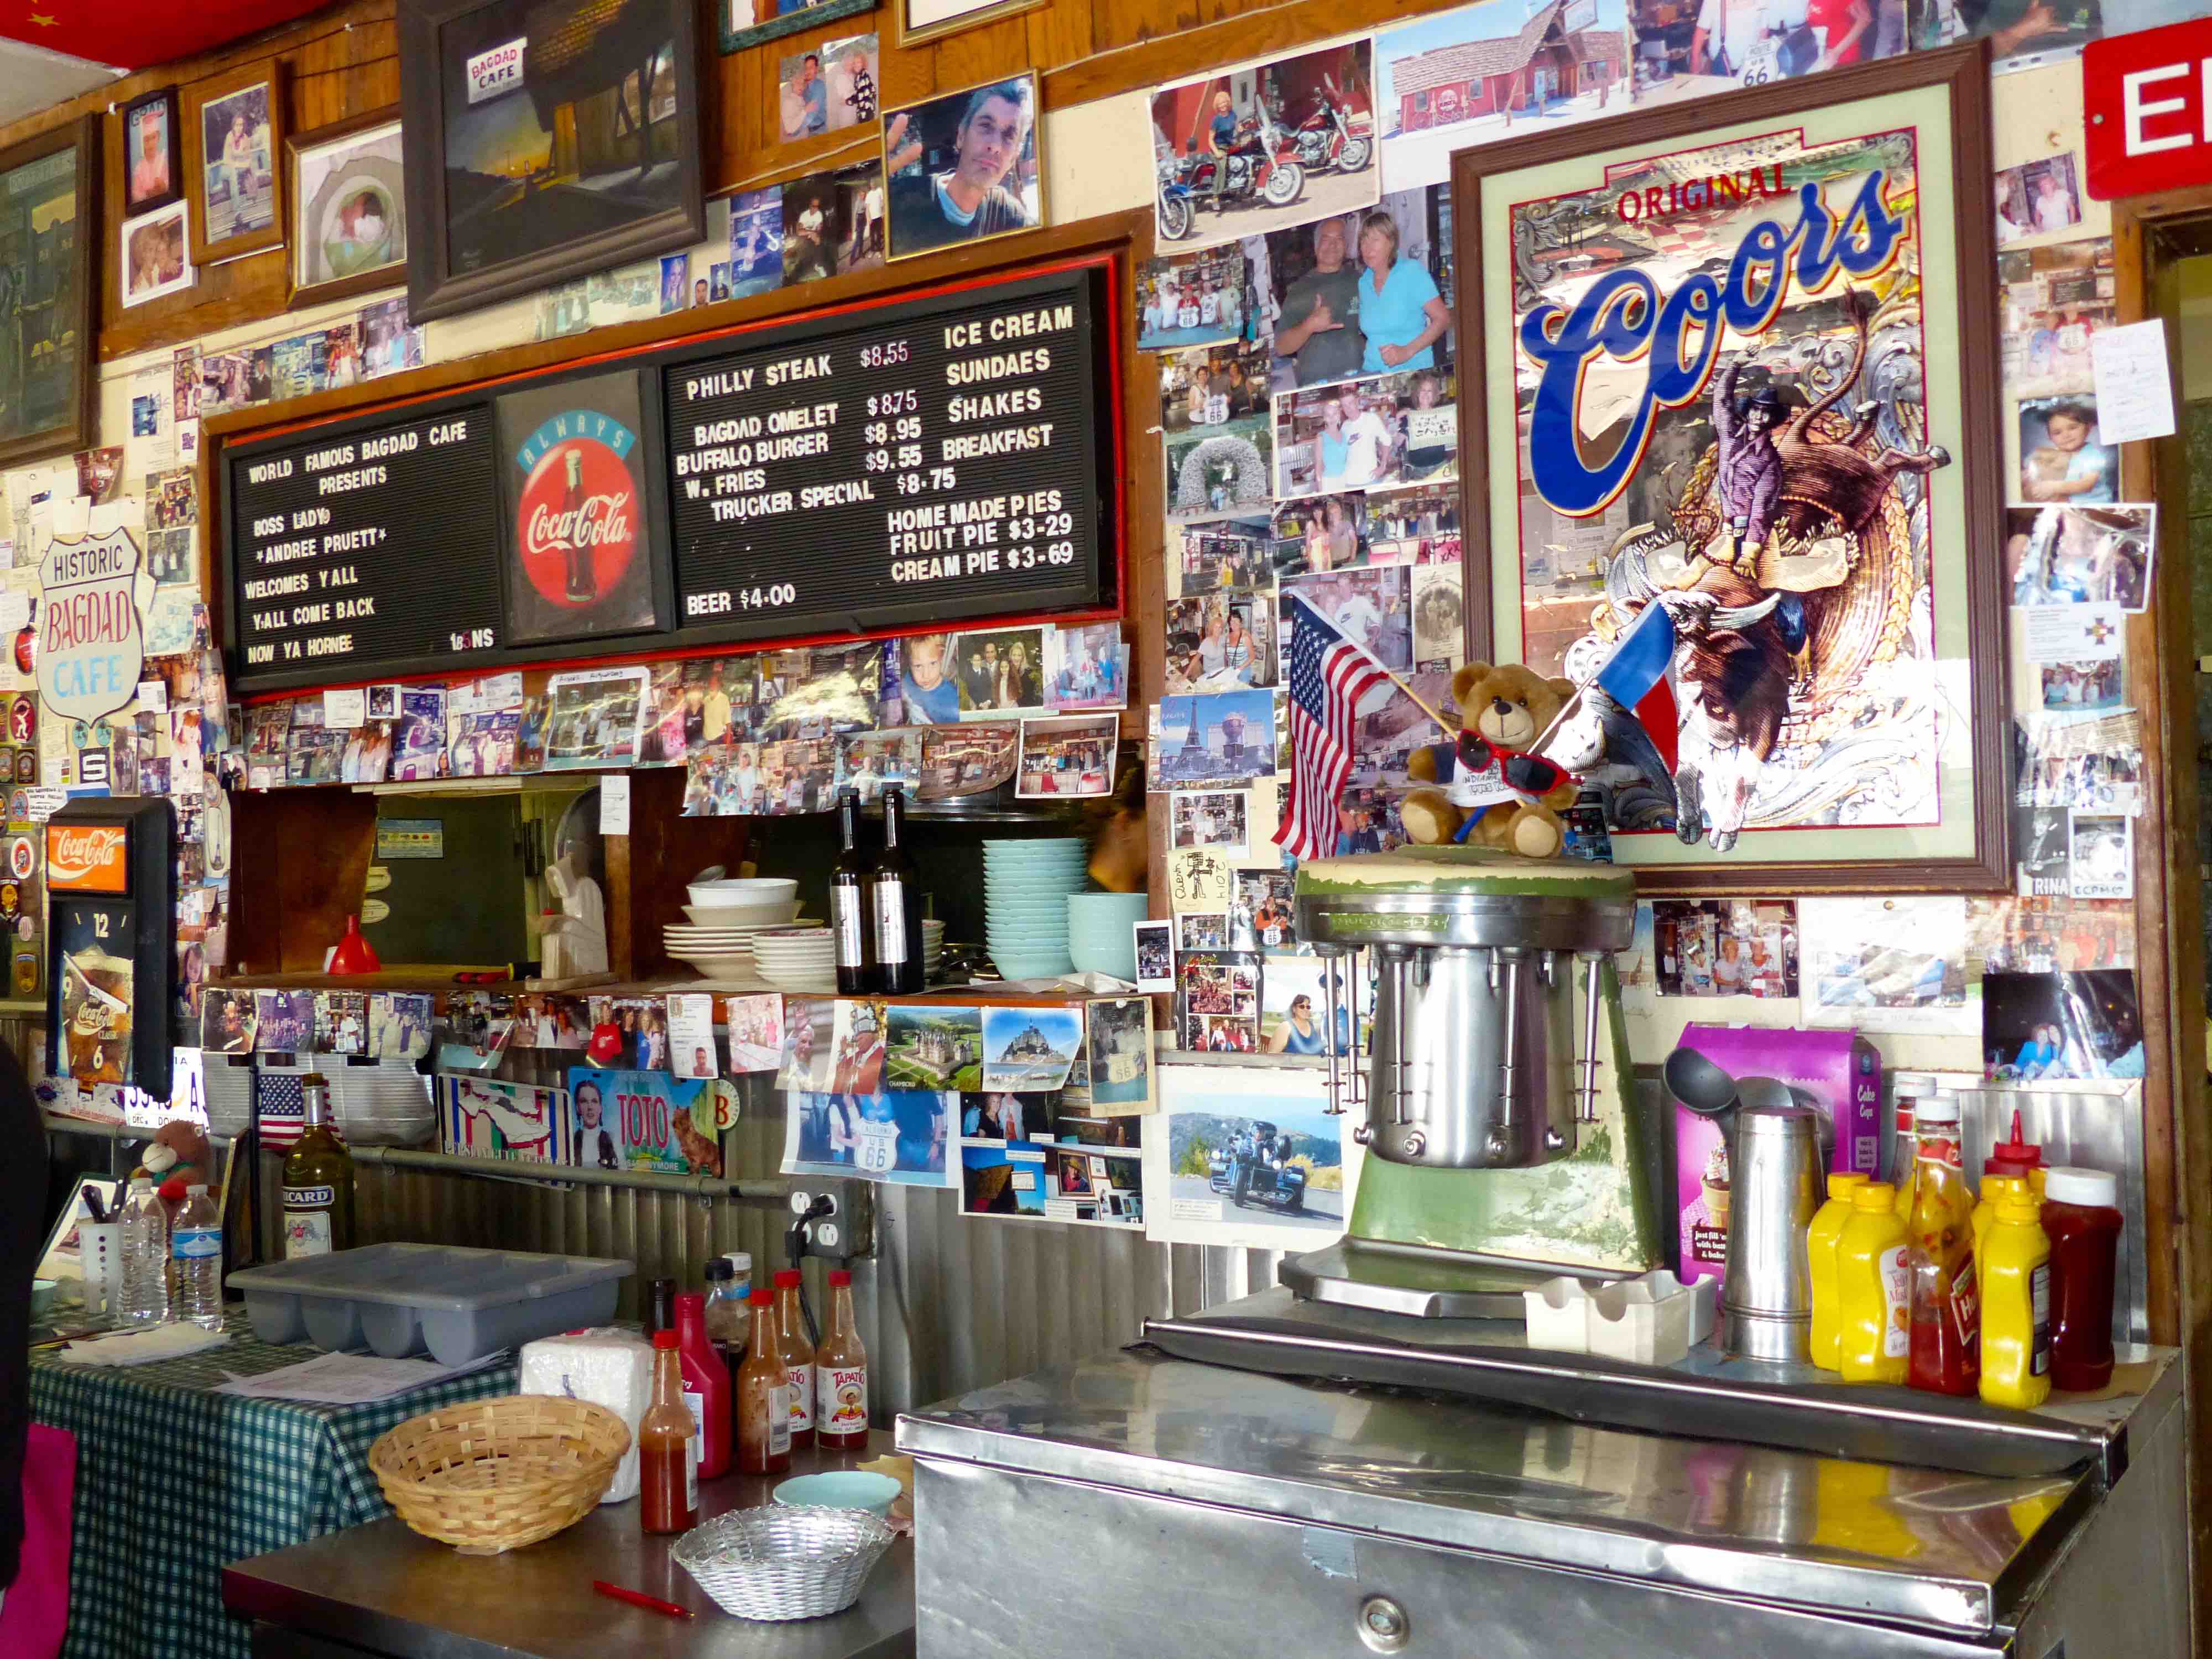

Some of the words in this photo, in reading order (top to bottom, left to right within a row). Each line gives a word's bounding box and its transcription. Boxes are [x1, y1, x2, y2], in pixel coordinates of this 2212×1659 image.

[472, 49, 517, 80] BAGDAD
[479, 64, 514, 88] CAFE
[1744, 65, 1768, 87] 66
[2123, 57, 2212, 158] E
[1617, 161, 1792, 224] ORIGINAL
[945, 322, 983, 349] ICE
[990, 305, 1073, 341] CREAM
[1520, 168, 1911, 520] Coors
[686, 368, 754, 400] PHILLY
[766, 355, 832, 387] STEAK
[860, 341, 909, 368] $8.55
[947, 348, 1051, 386] SUNDAES
[947, 388, 1043, 423] SHAKES
[523, 414, 624, 465] ALWAYS
[695, 416, 763, 447] BAGDAD
[768, 403, 839, 435] OMELET
[864, 417, 922, 446] $8.95
[942, 424, 1053, 461] BREAKFAST
[249, 459, 293, 484] WORLD
[305, 446, 354, 472] FAMOUS
[362, 432, 419, 461] BAGDAD
[429, 421, 467, 446] CAFE
[756, 432, 830, 462] BURGER
[865, 445, 923, 472] $9.55
[319, 466, 387, 495] PRESENTS
[716, 468, 766, 495] FRIES
[711, 490, 793, 522] TRUCKER
[801, 480, 875, 509] SPECIAL
[888, 504, 946, 534] HOME
[950, 494, 1007, 525] MADE
[1010, 489, 1062, 517] PIES
[254, 515, 284, 538] BOSS
[527, 491, 629, 554] Coca-Cola
[890, 527, 957, 556] FRUIT
[964, 520, 999, 547] PIE
[54, 544, 124, 583] HISTORIC
[891, 554, 961, 583] CREAM
[967, 549, 1000, 575] PIE
[245, 573, 309, 599] WELCOMES
[687, 591, 732, 616] BEER
[46, 589, 131, 654] BAGDAD
[293, 603, 330, 626] COME
[336, 597, 375, 620] BACK
[248, 644, 275, 664] NOW
[284, 640, 302, 659] YA
[54, 654, 125, 698] CAFE
[58, 829, 116, 867] Coca-Cola
[93, 913, 109, 938] 12
[64, 976, 72, 1000] 9
[93, 1045, 104, 1070] 6
[1857, 1083, 1876, 1102] Cake
[615, 1093, 669, 1149] TOTO
[865, 1146, 886, 1168] 66
[283, 1191, 328, 1202] ICARD
